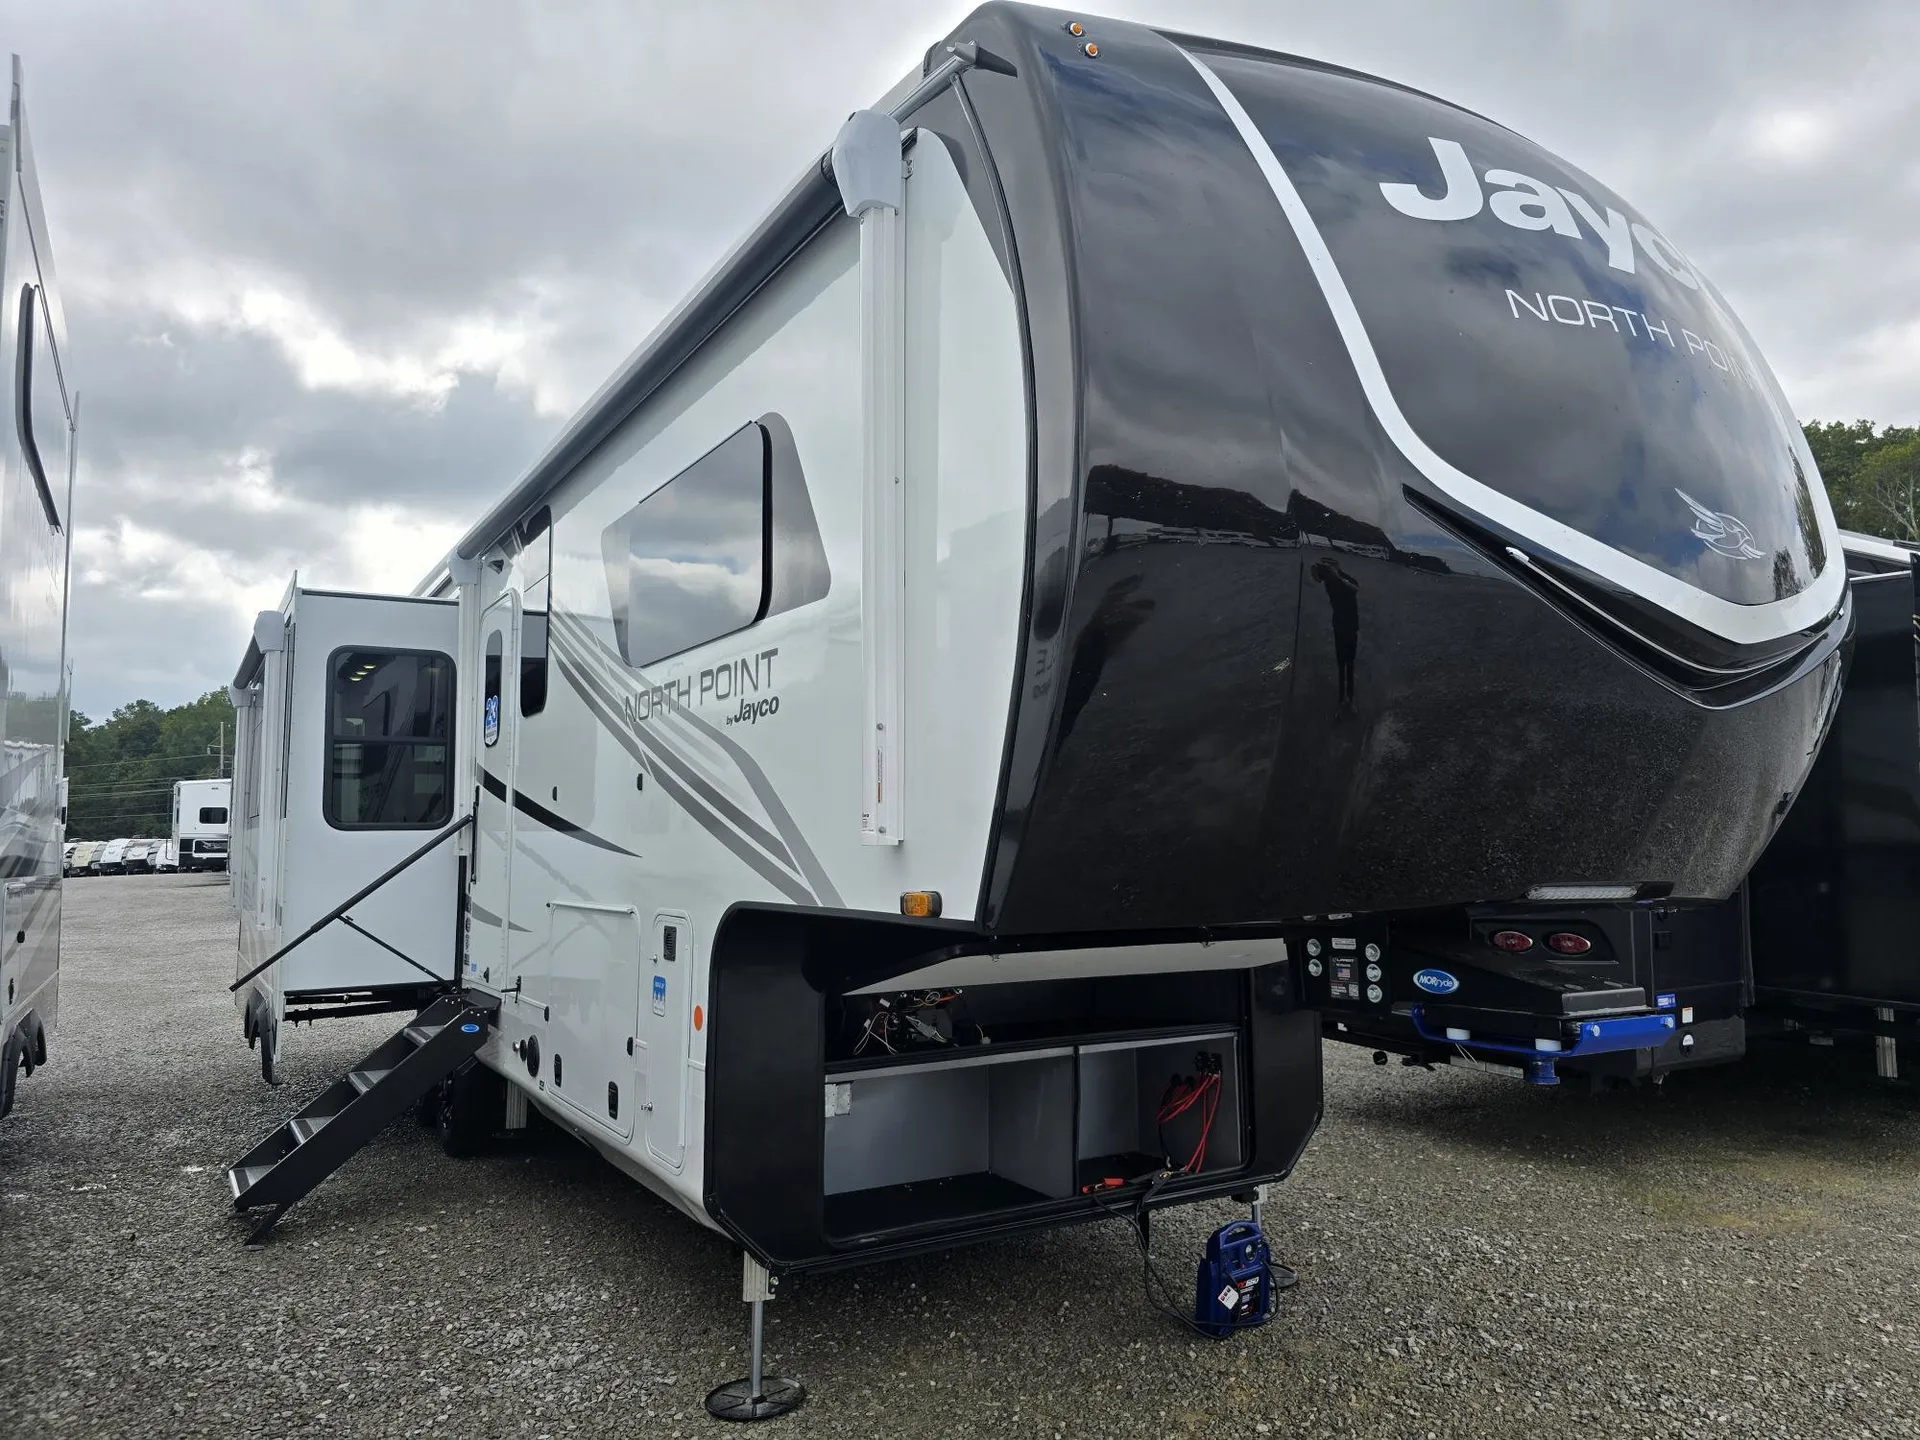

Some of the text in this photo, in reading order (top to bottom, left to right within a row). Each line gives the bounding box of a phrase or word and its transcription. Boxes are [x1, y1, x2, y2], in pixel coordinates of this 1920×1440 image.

[1504, 289, 1675, 349] NORTH
[625, 648, 779, 724] NORTH POINT
[726, 696, 779, 726] by Jayco
